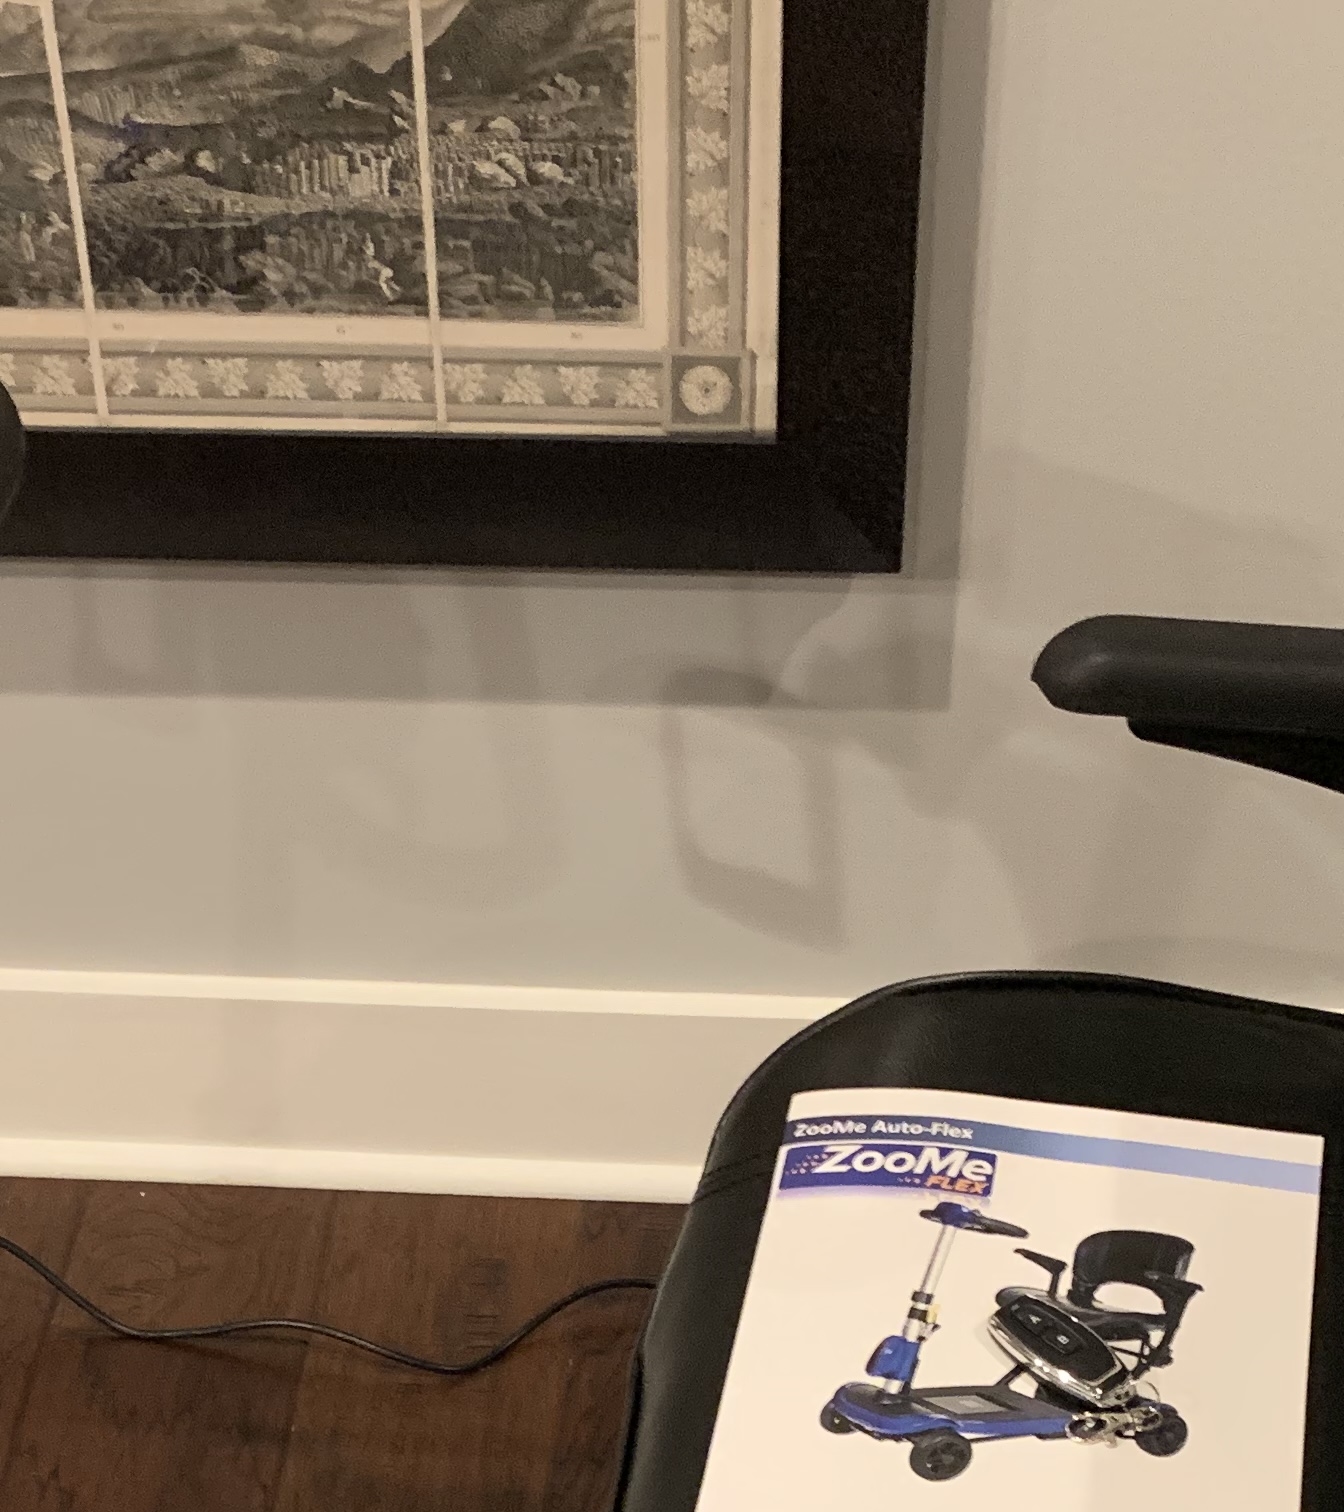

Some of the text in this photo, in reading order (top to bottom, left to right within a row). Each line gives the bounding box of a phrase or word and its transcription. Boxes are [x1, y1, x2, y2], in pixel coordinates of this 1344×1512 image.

[794, 1120, 974, 1140] ZooMe Auto-Flex
[811, 1144, 994, 1182] ZooMe
[924, 1175, 990, 1194] FLEX
